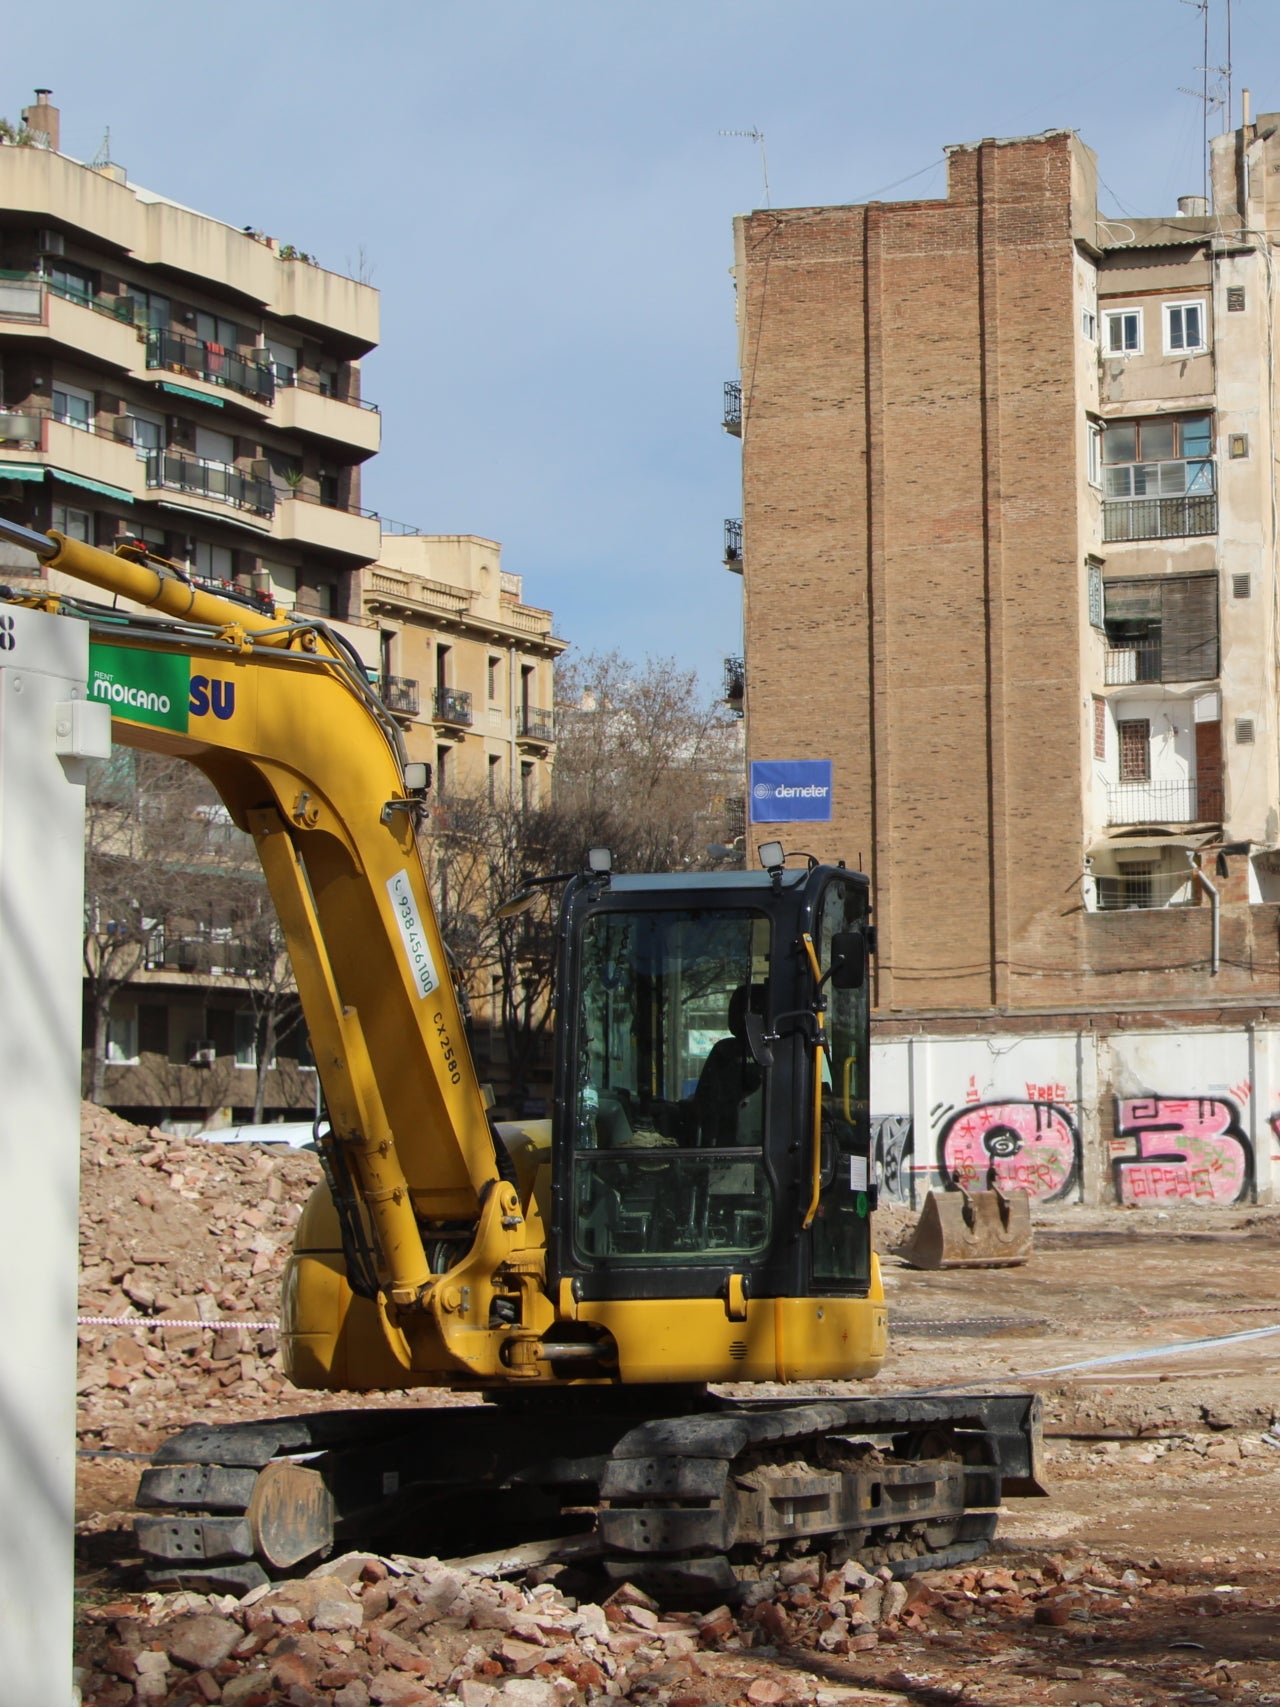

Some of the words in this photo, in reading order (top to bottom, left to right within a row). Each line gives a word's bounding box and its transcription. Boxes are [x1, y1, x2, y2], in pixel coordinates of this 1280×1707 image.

[94, 670, 114, 681] RENT
[189, 675, 235, 720] SU
[775, 784, 829, 798] demeter
[398, 896, 433, 993] 938456100
